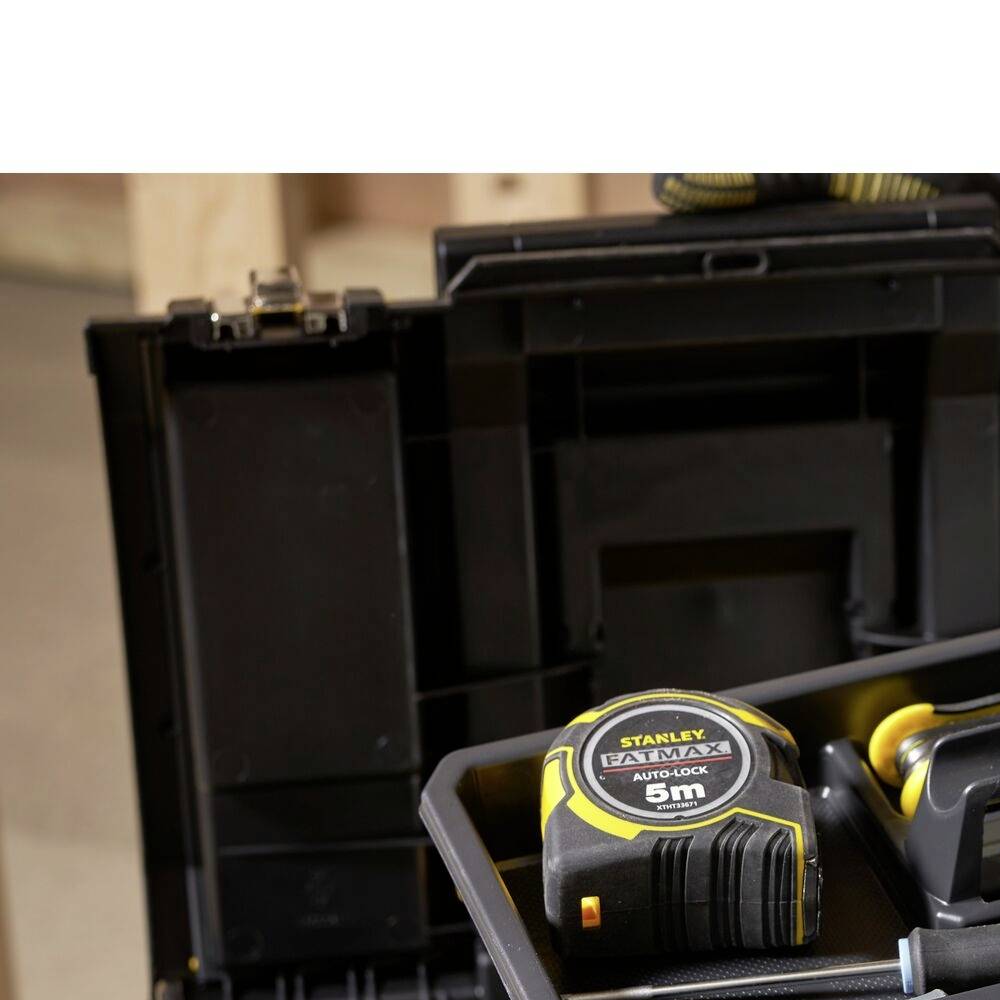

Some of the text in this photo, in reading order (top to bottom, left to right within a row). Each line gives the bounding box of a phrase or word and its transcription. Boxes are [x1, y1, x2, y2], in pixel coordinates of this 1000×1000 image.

[620, 728, 705, 748] STANLEY
[605, 742, 724, 766] FATMAX
[632, 765, 709, 782] AUTO-LOCK
[644, 782, 706, 804] 5m
